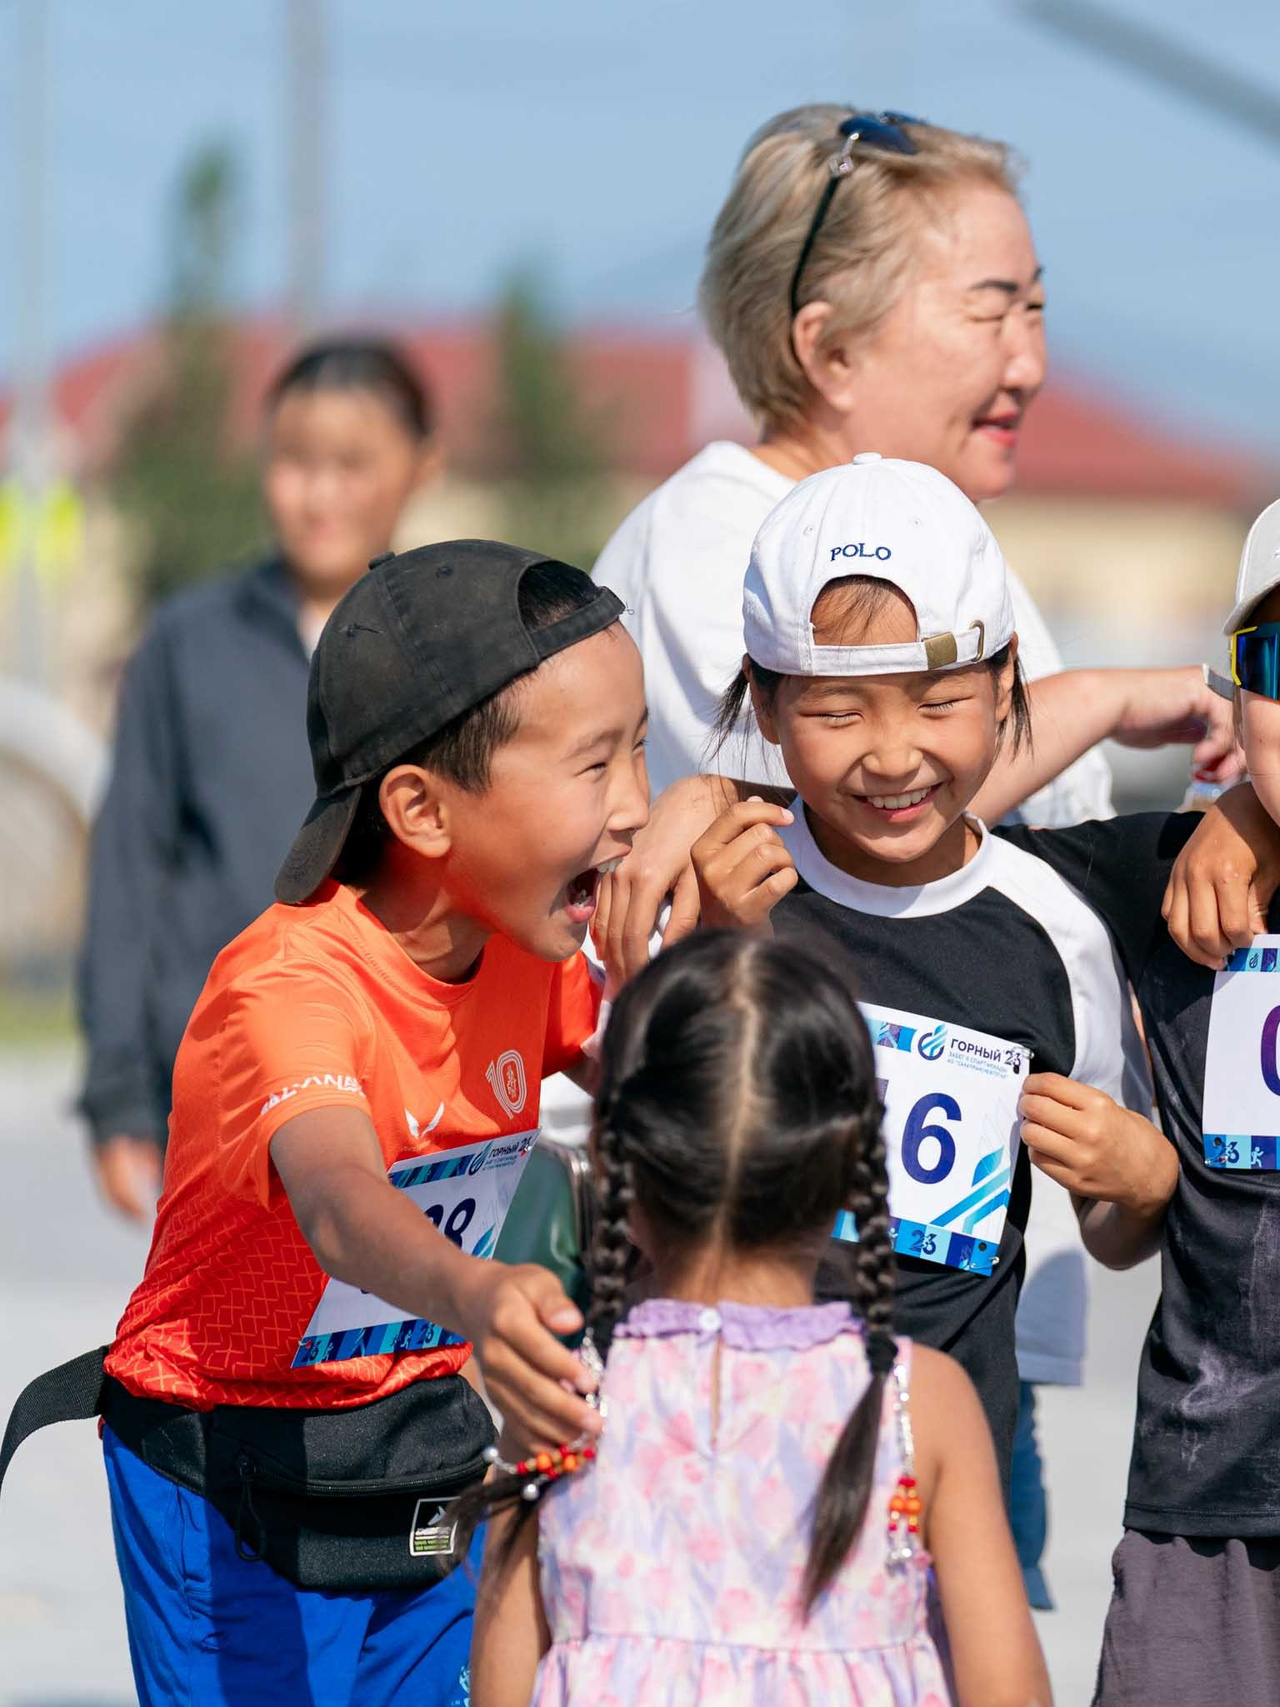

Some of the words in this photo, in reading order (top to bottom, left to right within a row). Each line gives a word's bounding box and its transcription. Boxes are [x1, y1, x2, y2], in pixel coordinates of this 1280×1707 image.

[830, 543, 891, 561] POLO
[950, 1038, 1001, 1062] ГОРНЫЙ
[882, 1080, 962, 1185] 6
